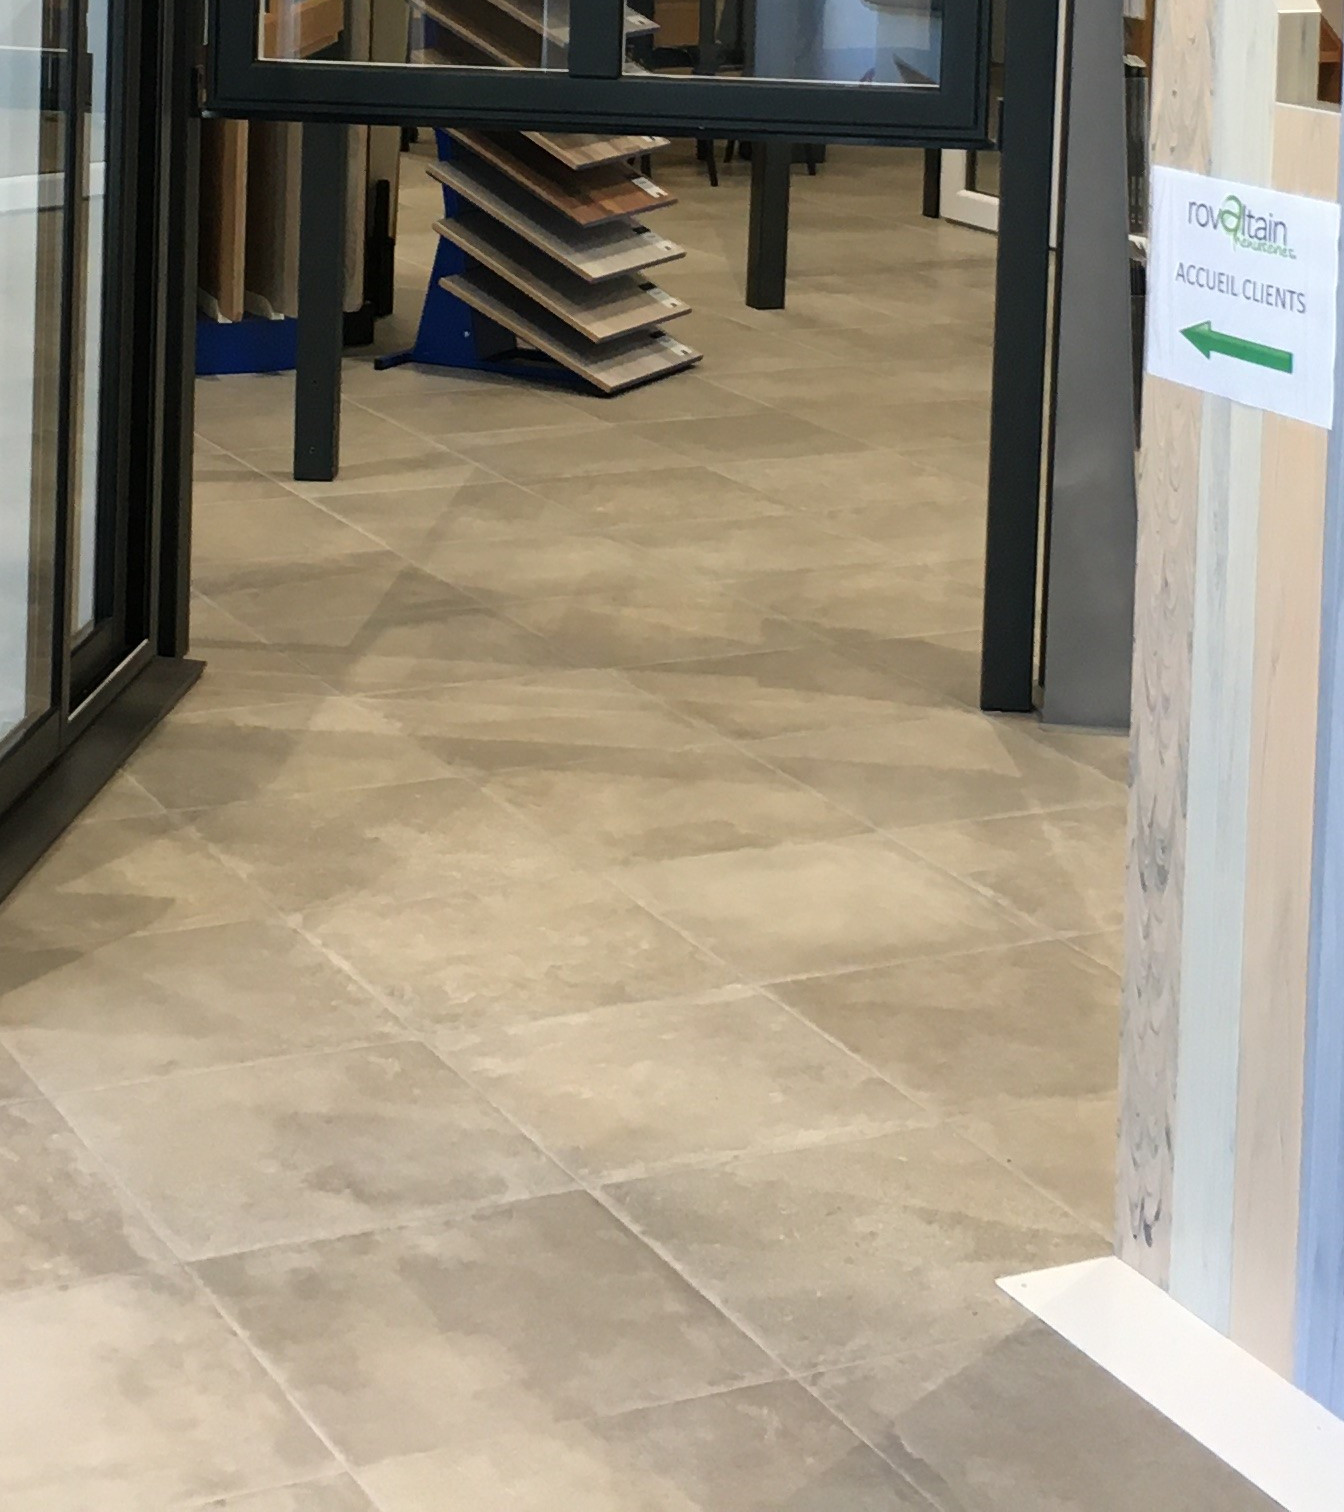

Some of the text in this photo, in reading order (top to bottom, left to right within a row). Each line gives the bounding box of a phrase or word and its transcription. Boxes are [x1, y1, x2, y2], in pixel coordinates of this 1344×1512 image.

[1188, 195, 1288, 245] rovaltain
[1175, 262, 1306, 313] ACCUEIL CLIENTS
